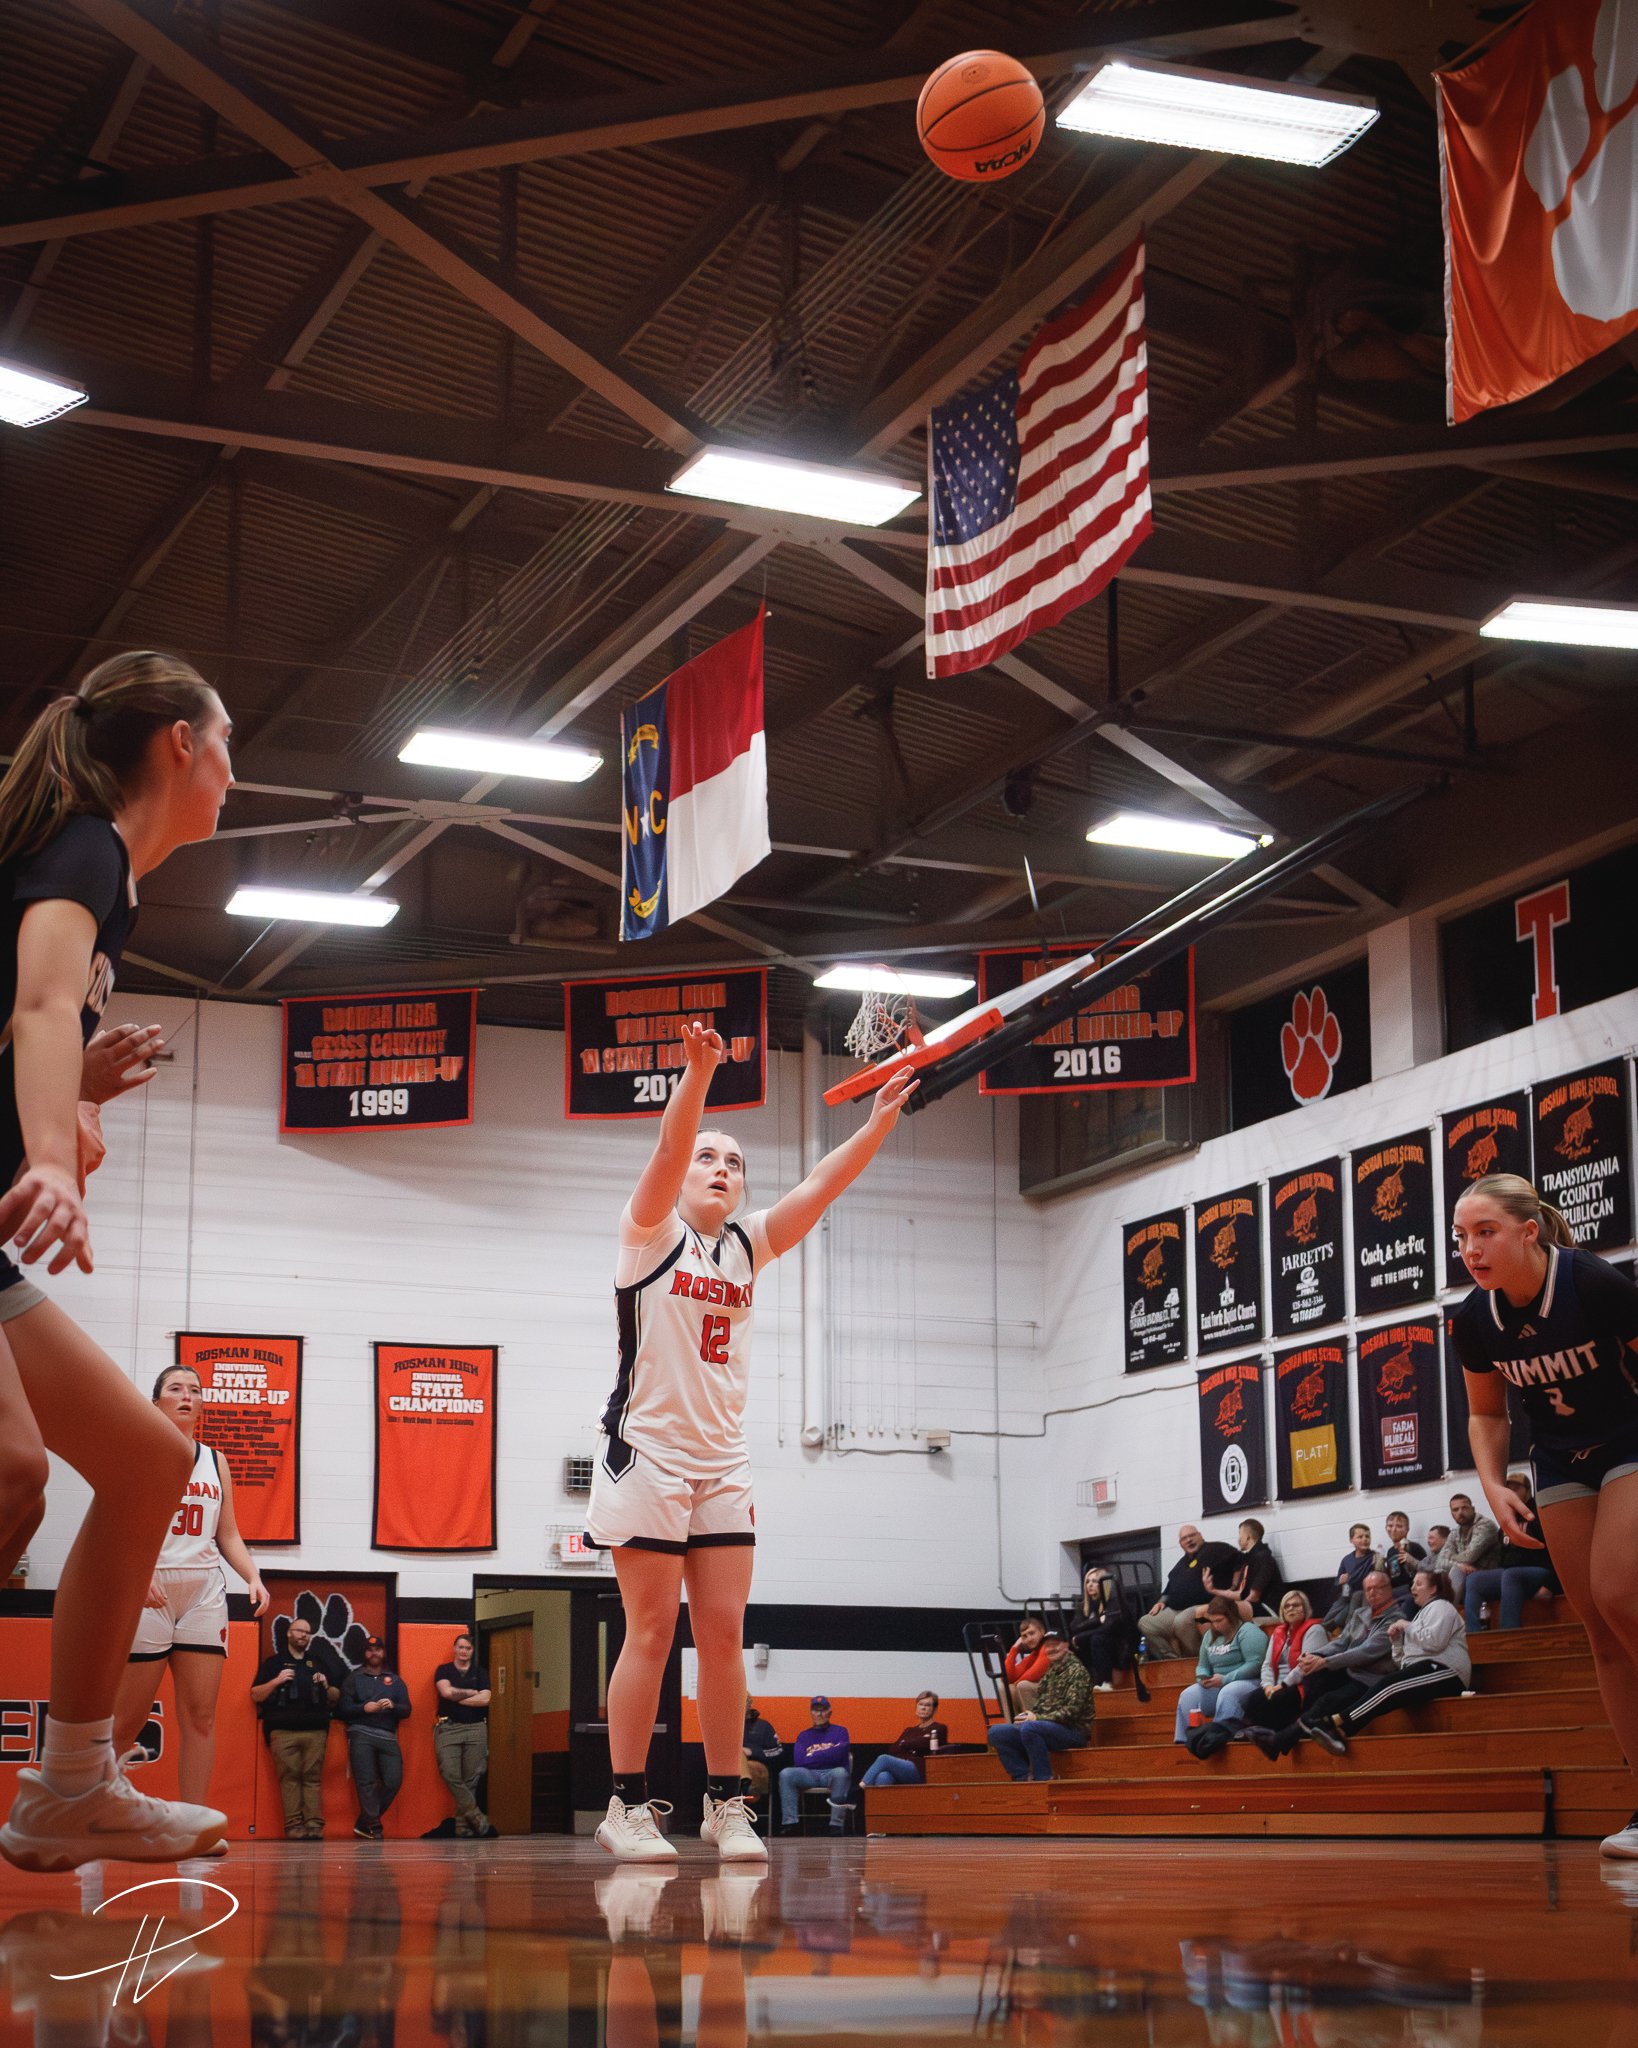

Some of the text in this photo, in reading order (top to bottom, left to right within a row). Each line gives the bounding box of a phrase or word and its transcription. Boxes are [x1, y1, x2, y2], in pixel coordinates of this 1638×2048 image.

[650, 789, 666, 835] C
[1515, 878, 1571, 1025] T
[1053, 1046, 1121, 1078] 2016
[633, 1073, 680, 1103] 201
[349, 1088, 409, 1117] 1999
[1542, 1155, 1620, 1192] TRANSYLVANIA
[1559, 1180, 1604, 1207] COUNTY
[1560, 1197, 1614, 1225] PUBLICAN
[1281, 1241, 1334, 1276] JARRETT'S
[669, 1269, 753, 1308] ROSMA
[1237, 1301, 1257, 1321] Church
[700, 1313, 731, 1365] 12
[1407, 1325, 1435, 1345] SCHOOL
[195, 1347, 284, 1366] ROSMAN HIGH
[393, 1357, 479, 1376] ROSMAN HIGH
[1492, 1340, 1600, 1388] SUMMIT
[211, 1372, 268, 1389] STATE
[410, 1381, 464, 1398] STATE
[201, 1387, 291, 1406] UNNER-UP
[389, 1396, 485, 1414] CHAMPIONS
[1384, 1430, 1416, 1449] BUREAU
[1392, 1419, 1416, 1434] FARM
[185, 1481, 220, 1502] MAN
[172, 1503, 204, 1537] 30
[569, 1534, 593, 1553] EX
